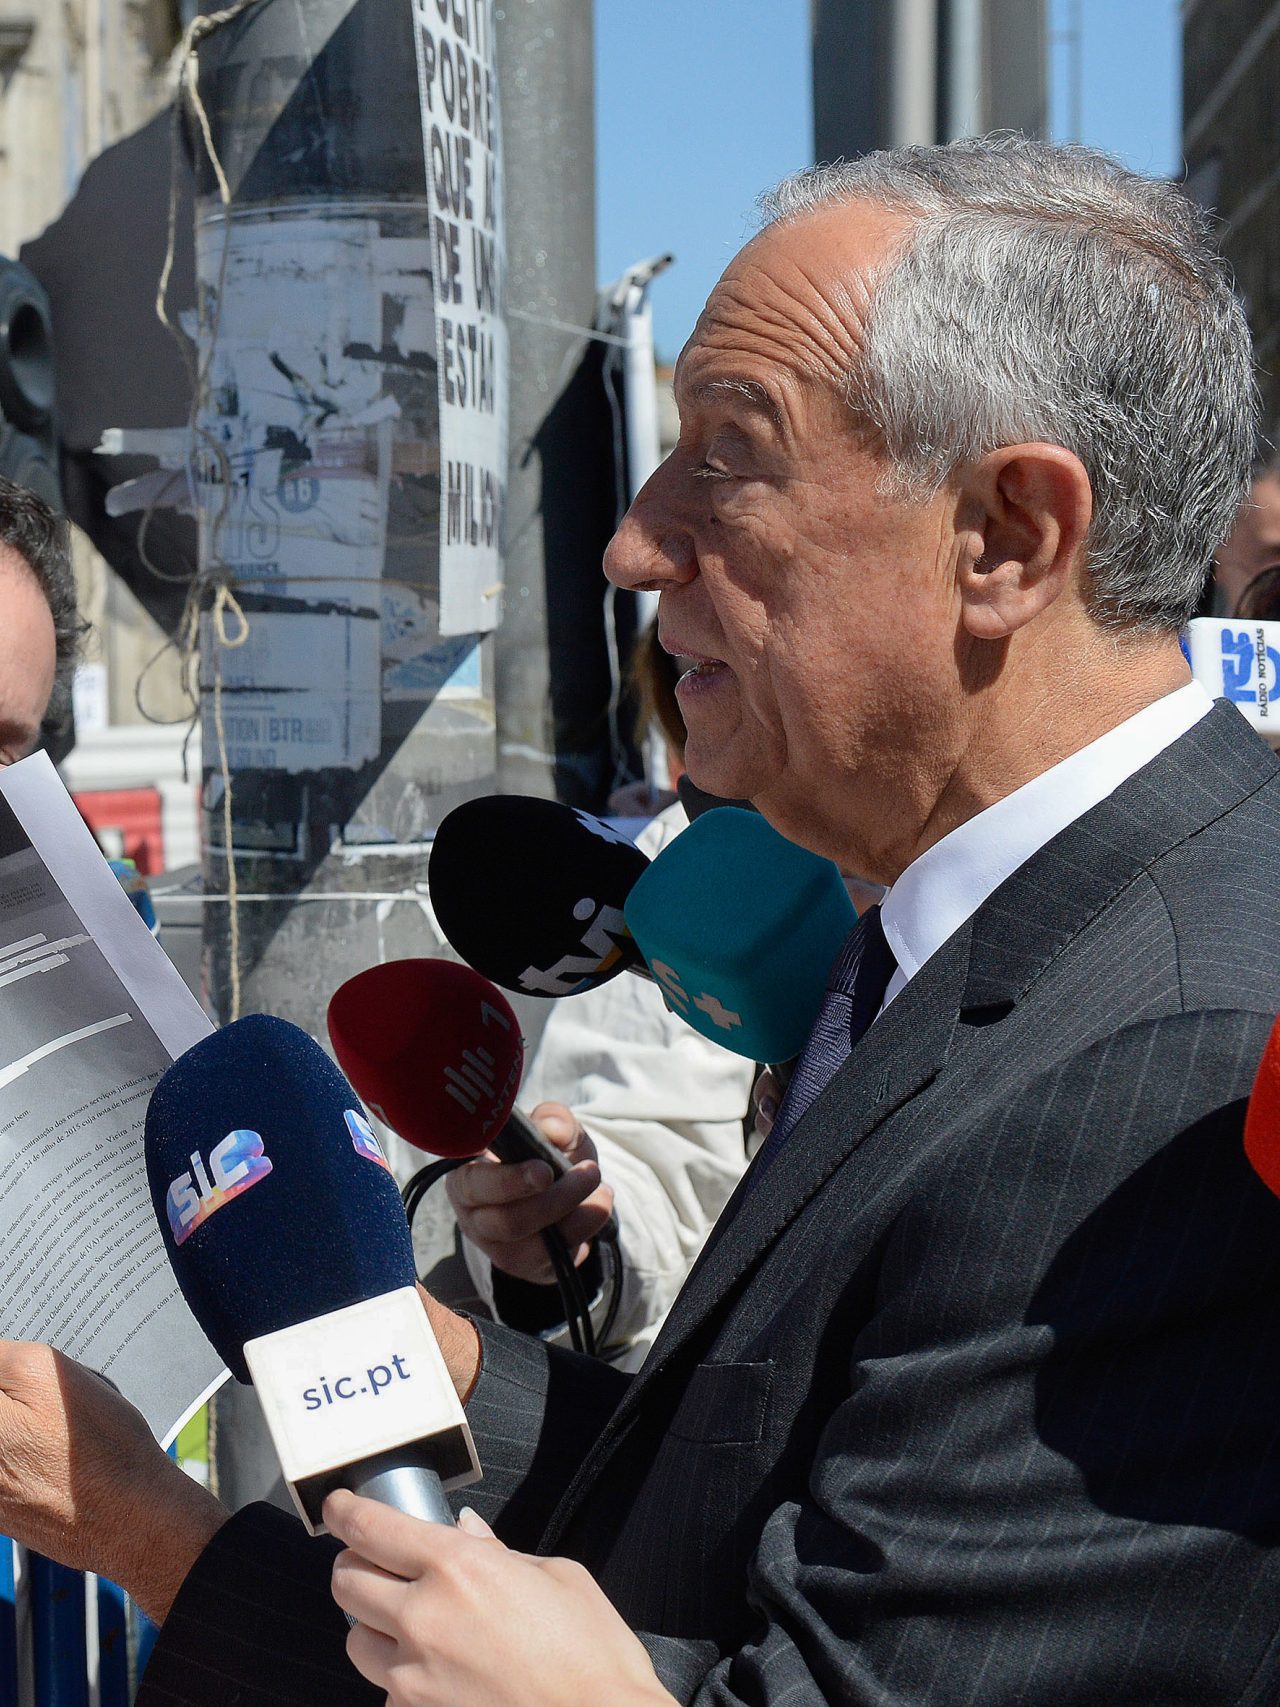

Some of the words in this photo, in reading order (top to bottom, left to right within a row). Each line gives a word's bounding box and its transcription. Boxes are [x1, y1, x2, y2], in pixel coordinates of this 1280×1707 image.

[431, 123, 473, 220] QUE
[435, 212, 463, 305] DE
[1255, 628, 1266, 678] NOTÍCIAS
[1257, 683, 1268, 717] RÁDIO
[21, 1126, 54, 1153] contratação
[66, 1104, 89, 1120] nossos
[89, 1090, 117, 1105] serviços
[116, 1076, 146, 1093] jurídicos
[39, 1142, 56, 1157] julho
[65, 1123, 81, 1138] 2015
[81, 1115, 96, 1127] cuja
[96, 1107, 112, 1118] nota
[41, 1173, 63, 1192] serviços
[64, 1151, 92, 1174] jurídicos
[105, 1129, 128, 1143] Vieira
[51, 1189, 66, 1205] pelos
[66, 1168, 92, 1189] senhores
[93, 1151, 118, 1170] perdido
[118, 1139, 137, 1154] junto
[58, 1202, 73, 1216] Com
[72, 1189, 91, 1204] efeito,
[94, 1171, 113, 1186] nossa
[112, 1151, 146, 1173] sociedade
[63, 1201, 97, 1233] extrajudiciais
[114, 1173, 134, 1190] seguir
[98, 1224, 115, 1240] sobre
[119, 1208, 135, 1222] valor
[16, 1297, 31, 1313] Vieira
[100, 1206, 115, 1219] uma
[115, 1186, 142, 1209] provisão
[113, 1266, 136, 1291] proceder
[141, 1244, 165, 1263] cobranç
[77, 1334, 95, 1355] devidos
[135, 1263, 163, 1291] praticados
[124, 1309, 157, 1344] subscrevemos
[302, 1352, 411, 1411] sic.pt
